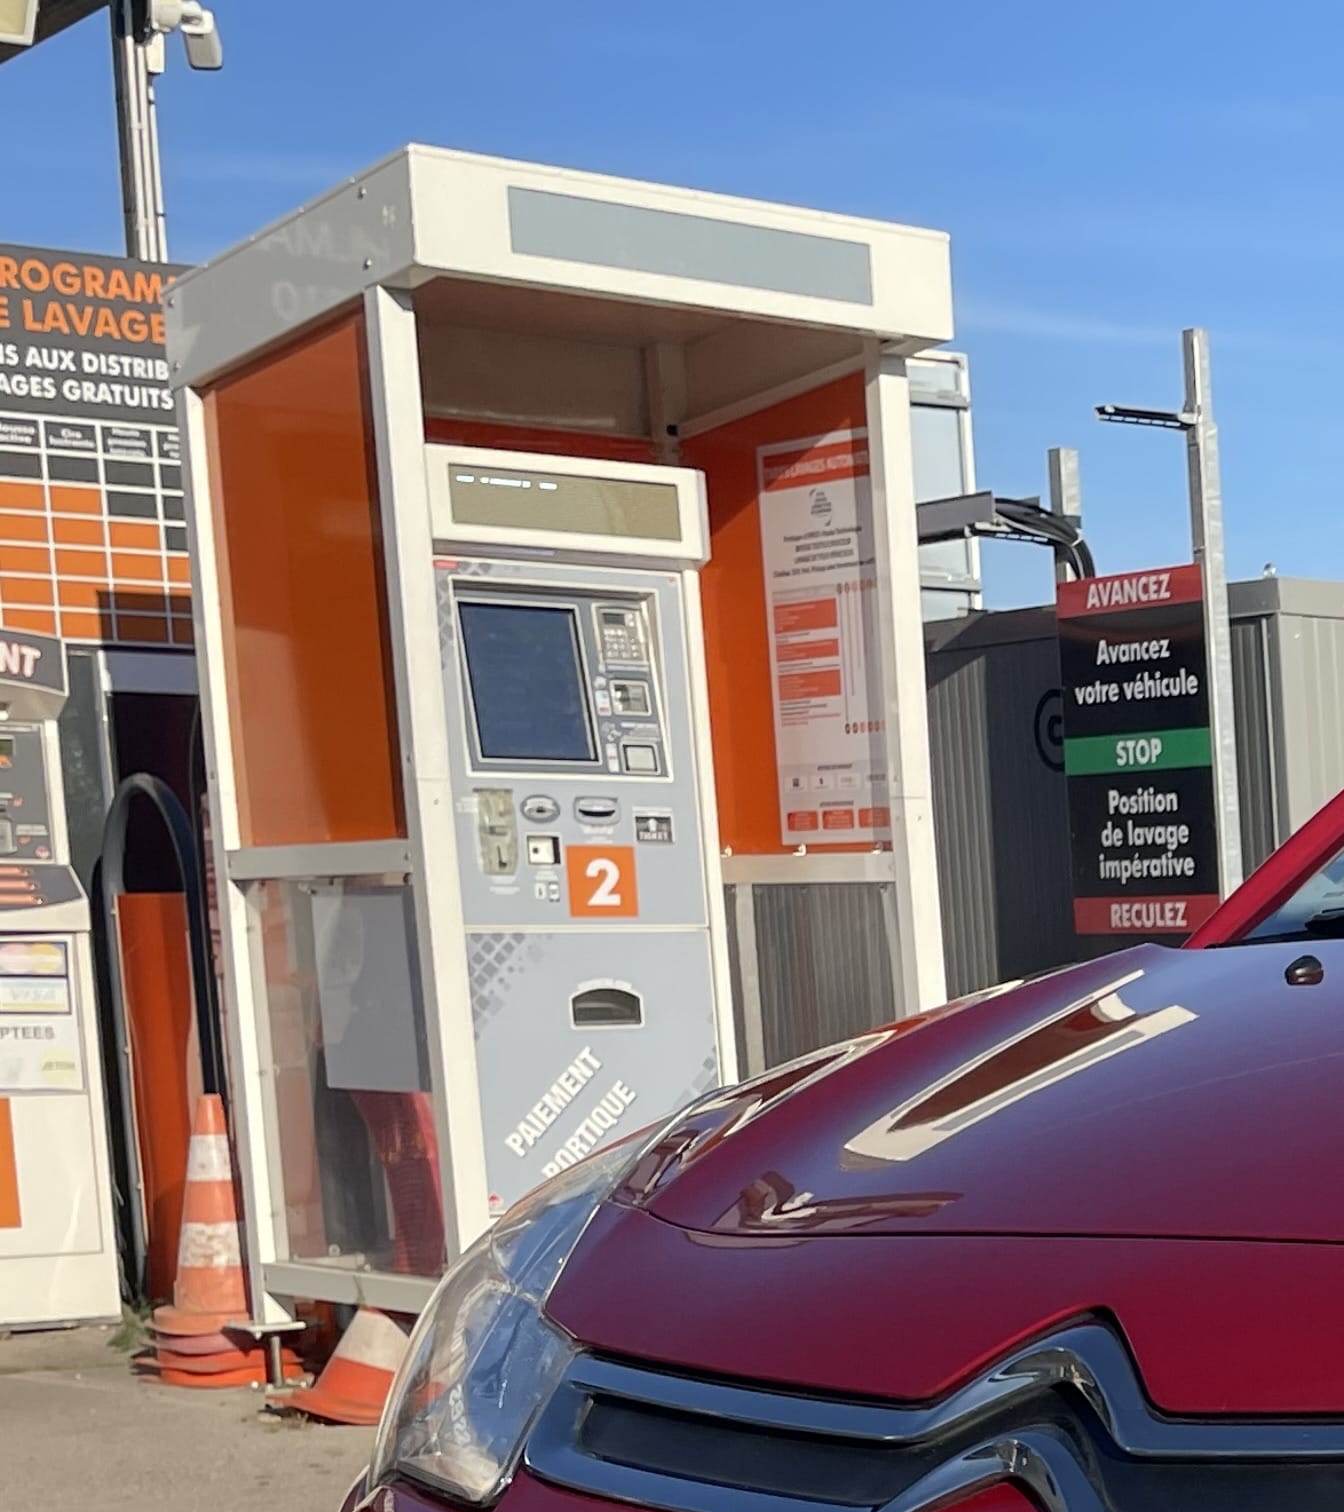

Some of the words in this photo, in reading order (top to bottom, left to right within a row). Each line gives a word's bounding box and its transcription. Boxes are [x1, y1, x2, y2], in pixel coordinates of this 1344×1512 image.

[0, 255, 176, 304] ROGRAM
[25, 346, 76, 372] AUX
[81, 352, 169, 381] DISTRIB
[62, 379, 174, 410] GRATUITS
[1086, 572, 1171, 609] AVANCEZ
[1096, 639, 1170, 666] Avancez
[1074, 681, 1119, 706] votre
[1125, 668, 1199, 702] véhicule
[1116, 737, 1162, 766] STOP
[1108, 788, 1178, 816] Position
[1101, 822, 1122, 848] de
[1128, 819, 1190, 851] lavage
[585, 858, 621, 906] 2
[1099, 852, 1195, 885] impérative
[1110, 902, 1187, 929] RECULEZ
[504, 1046, 603, 1158] PAIEMENT
